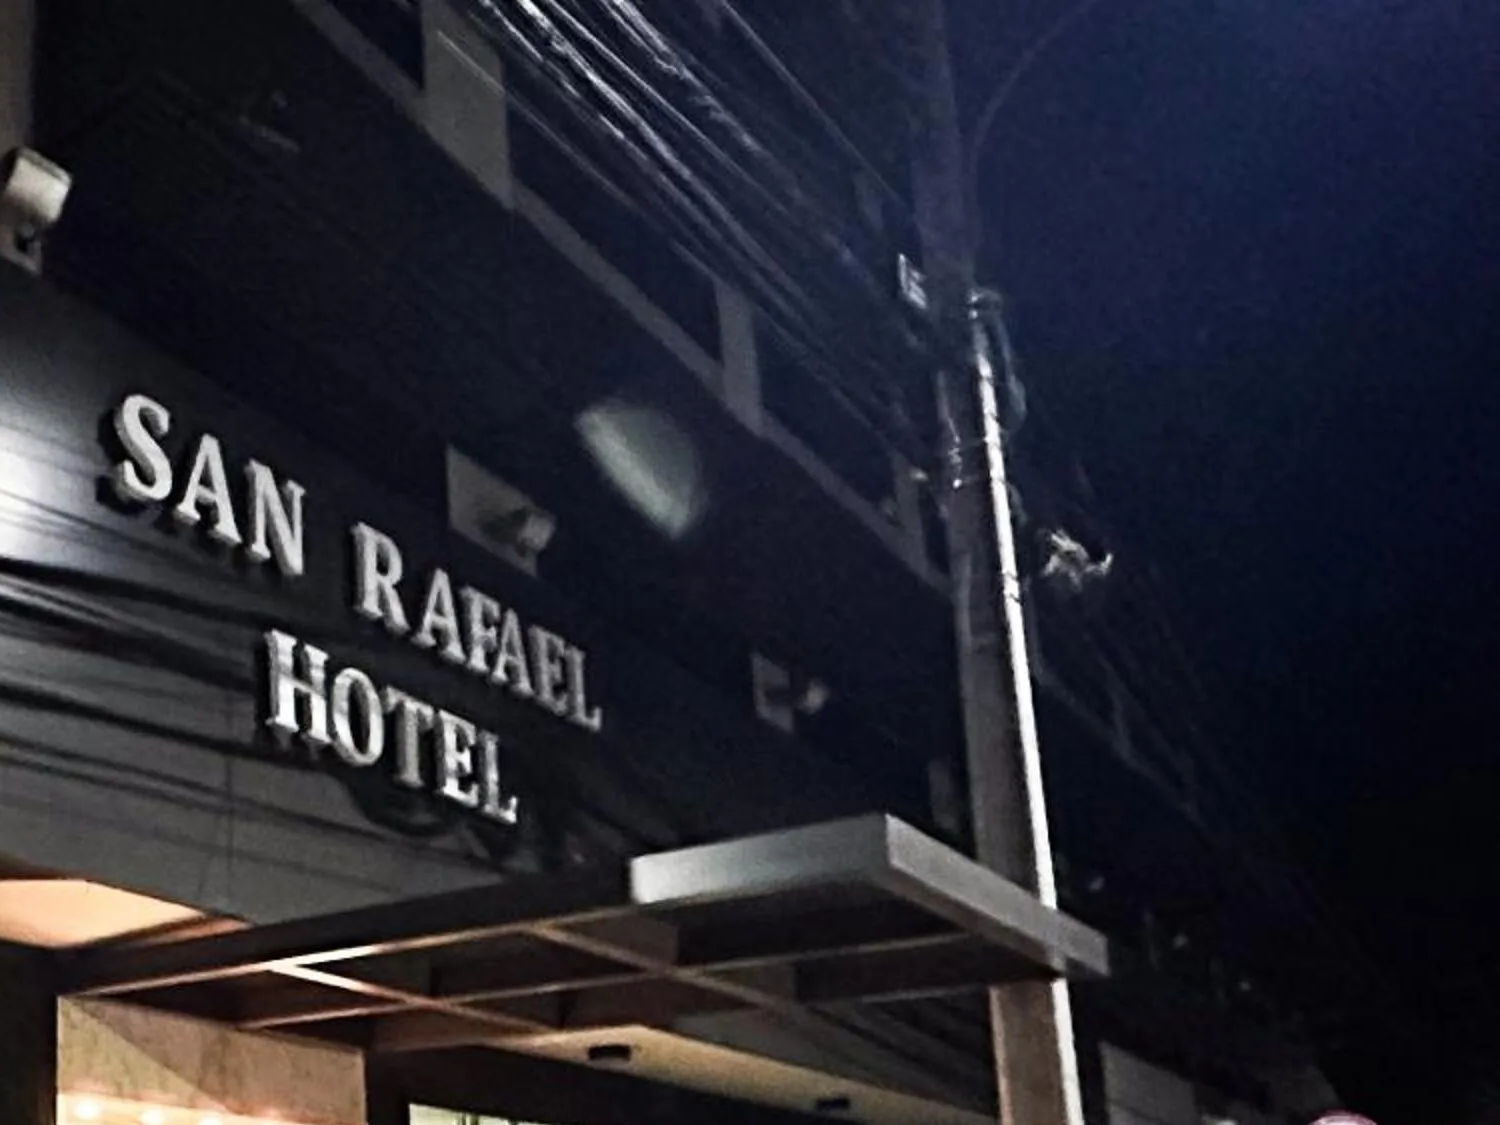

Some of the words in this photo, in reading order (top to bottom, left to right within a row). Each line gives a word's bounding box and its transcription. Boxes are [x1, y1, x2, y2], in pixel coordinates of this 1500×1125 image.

[114, 394, 305, 575] SAN
[350, 521, 601, 732] RAFAEL
[264, 628, 518, 824] HOTEL
